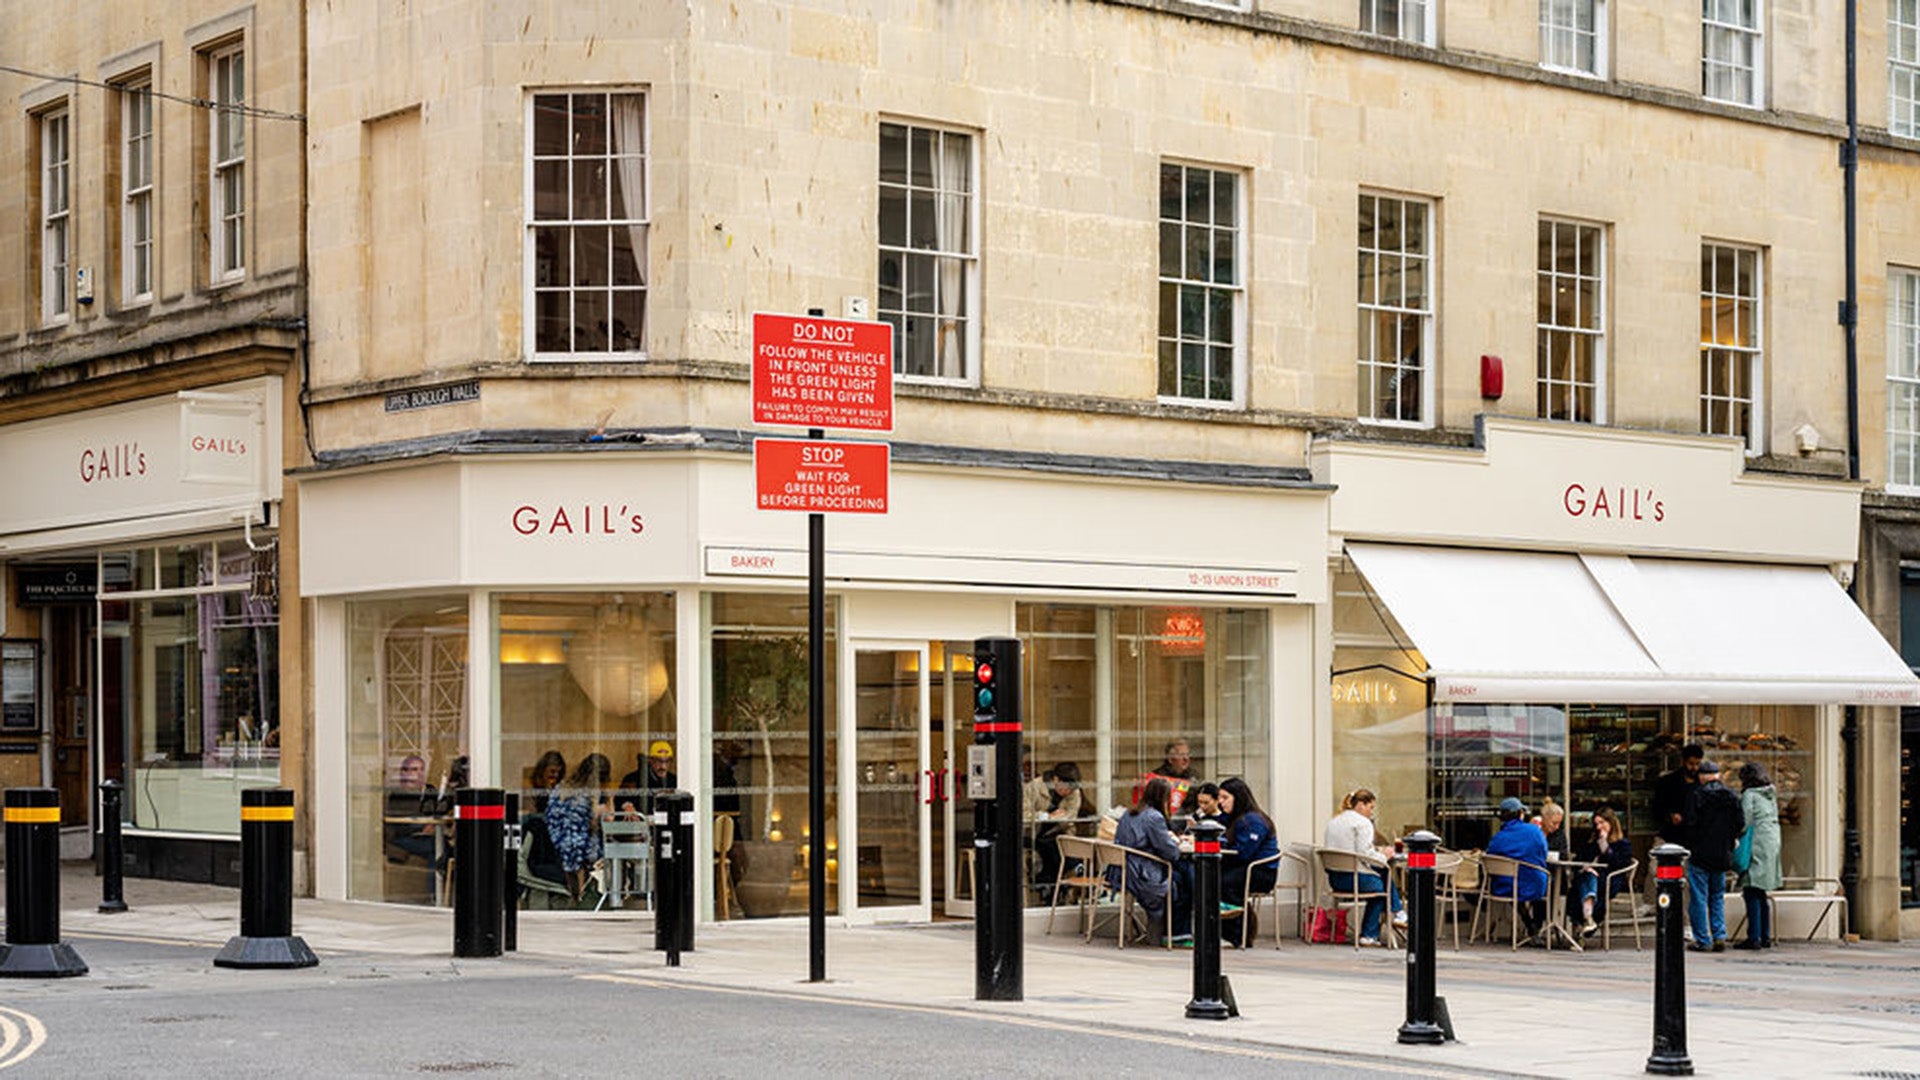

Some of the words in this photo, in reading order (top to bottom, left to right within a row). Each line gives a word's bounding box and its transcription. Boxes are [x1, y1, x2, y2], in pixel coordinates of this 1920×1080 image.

[793, 323, 817, 339] DO
[822, 325, 854, 342] NOT
[760, 344, 808, 359] FOLLOW
[811, 348, 833, 360] THE
[837, 351, 886, 365] VEHICLE
[769, 360, 782, 371] IN
[787, 361, 826, 373] FRONT
[830, 364, 877, 378] UNLESS
[770, 372, 793, 385] THE
[797, 375, 838, 388] GREEN
[842, 379, 876, 391] LIGHT
[387, 395, 409, 409] UPPER
[411, 389, 450, 407] BOROUGH
[452, 383, 480, 399] WALLS
[772, 387, 797, 399] HAS
[801, 388, 834, 401] BEEN
[837, 391, 874, 404] GIVEN
[757, 401, 790, 411] FAILURE
[793, 404, 803, 412] TO
[805, 404, 838, 414] COMPLY
[840, 407, 857, 415] MAY
[859, 409, 888, 418] RESULT
[775, 413, 811, 422] DAMAGE
[813, 414, 824, 423] TO
[826, 415, 847, 424] YOUR
[849, 417, 882, 426] VEHICLE
[192, 435, 247, 455] GAIL's
[80, 443, 147, 483] GAIL's
[802, 447, 844, 462] STOP
[796, 470, 824, 482] WAIT
[827, 471, 850, 483] FOR
[785, 482, 825, 494] GREEN
[828, 484, 861, 496] LIGHT
[761, 494, 806, 506] BEFORE
[810, 496, 884, 509] PROCEEDING
[1564, 483, 1665, 522] GAIL's
[512, 505, 644, 535] GAIL's
[731, 555, 775, 569] BAKERY
[1214, 575, 1244, 586] UNION
[1246, 575, 1280, 588] STREET
